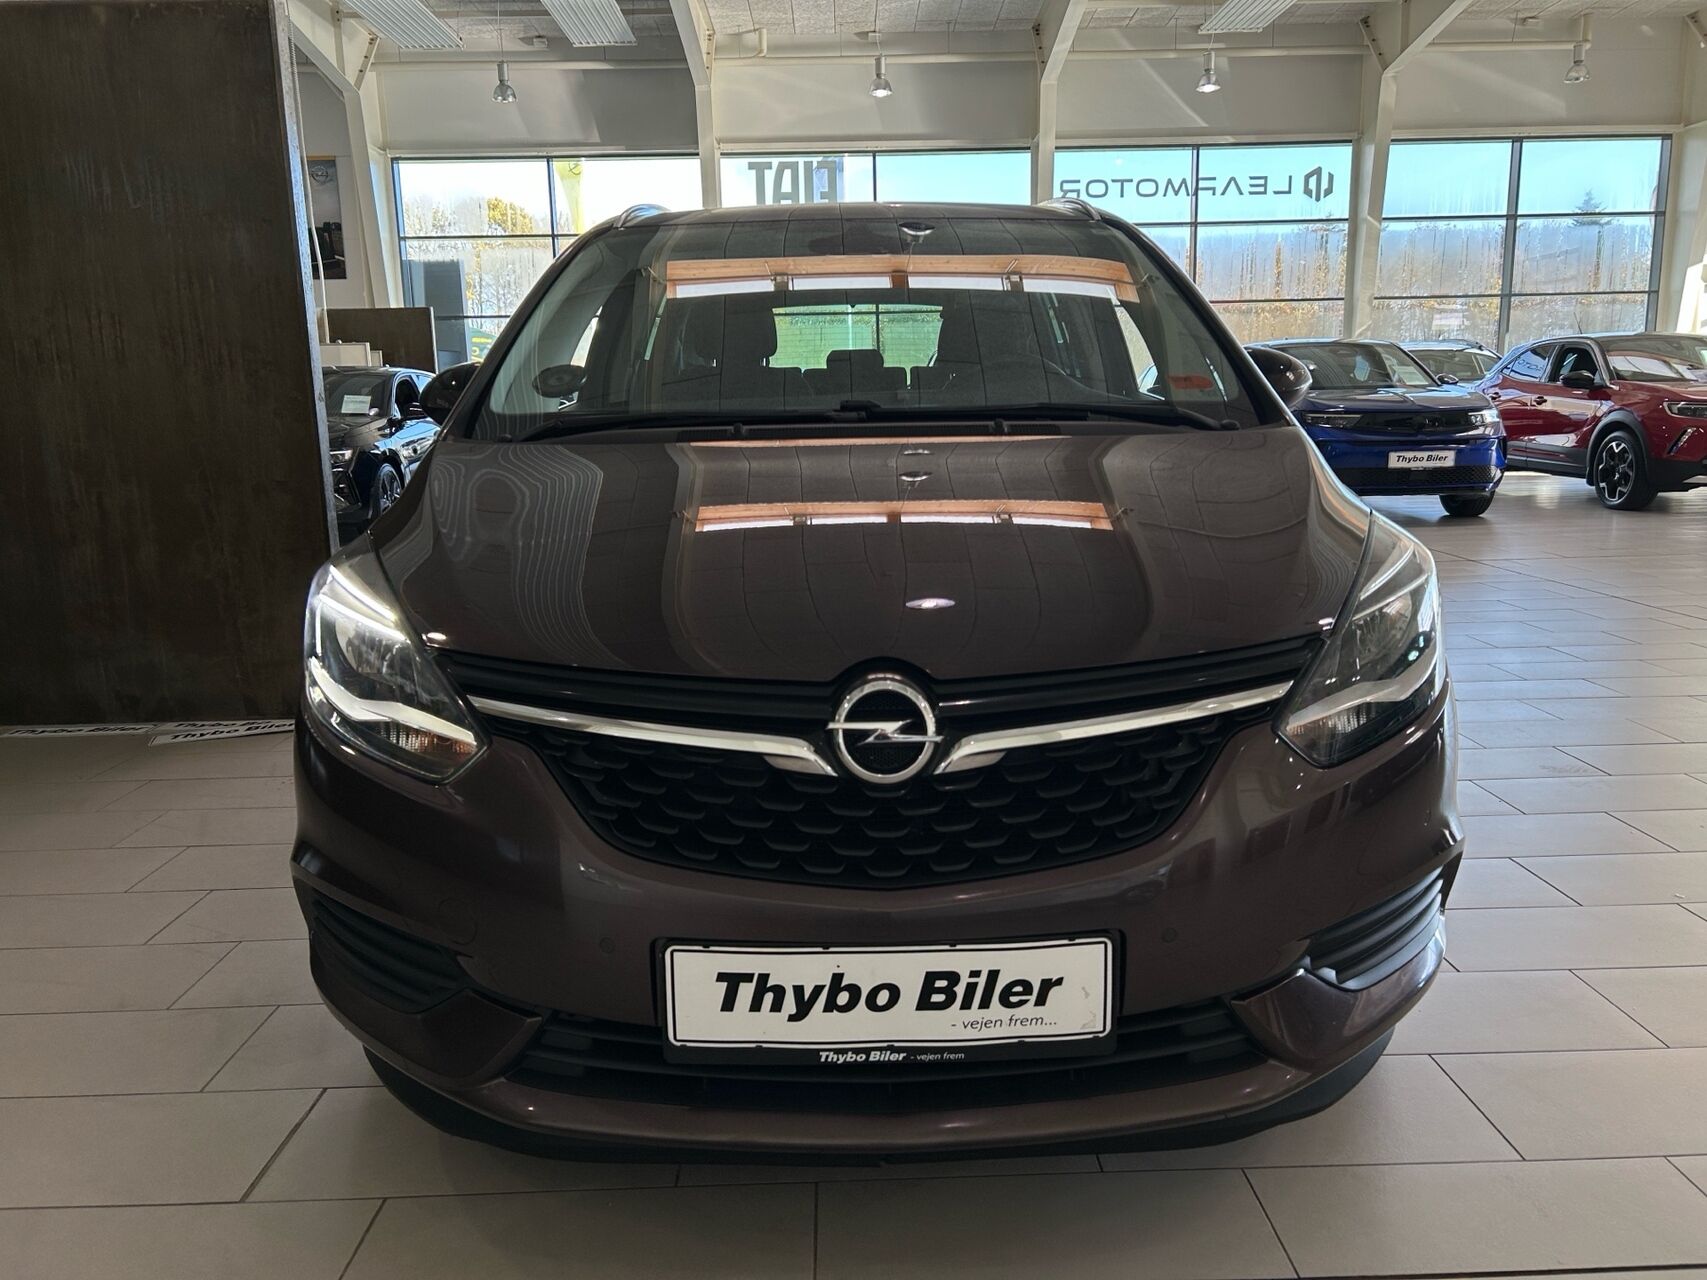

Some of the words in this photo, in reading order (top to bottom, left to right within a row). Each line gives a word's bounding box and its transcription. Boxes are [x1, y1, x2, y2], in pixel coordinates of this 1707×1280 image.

[1396, 455, 1424, 463] Thybo
[1426, 454, 1448, 462] Biler
[171, 729, 240, 740] Thybo
[715, 971, 901, 1022] Thybo
[915, 969, 1064, 1012] Biler
[962, 1017, 1003, 1032] vejen
[1008, 1014, 1057, 1027] frem...
[819, 1051, 866, 1064] Thybo
[868, 1051, 906, 1062] Biler
[916, 1053, 941, 1062] vejen
[943, 1052, 965, 1060] frem
